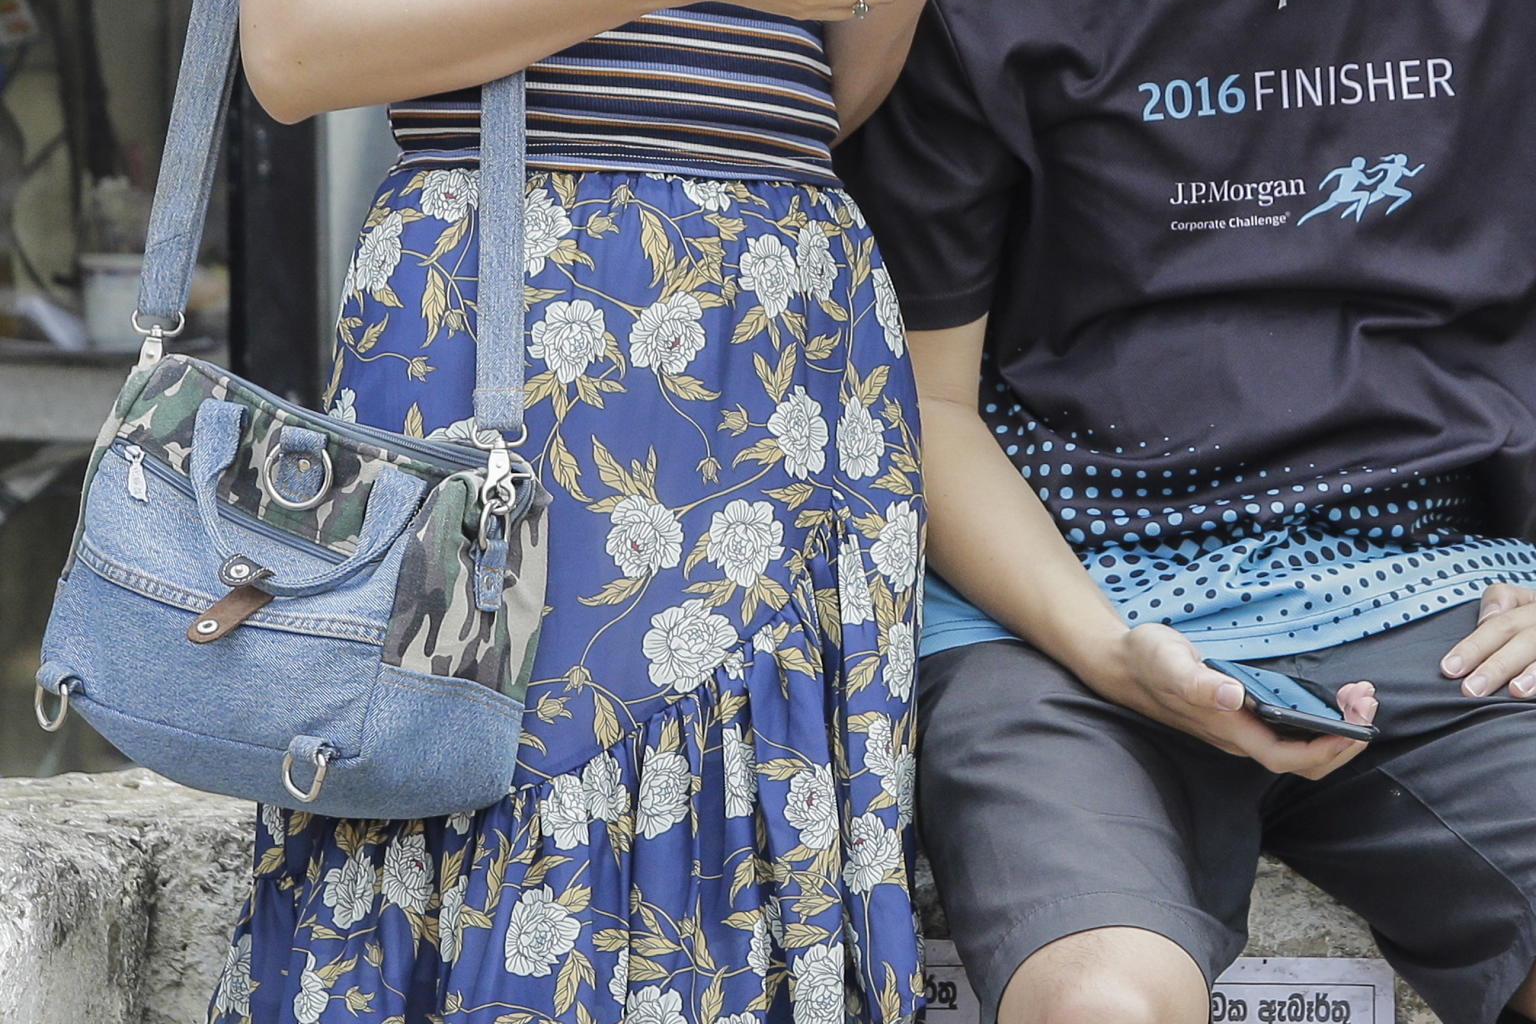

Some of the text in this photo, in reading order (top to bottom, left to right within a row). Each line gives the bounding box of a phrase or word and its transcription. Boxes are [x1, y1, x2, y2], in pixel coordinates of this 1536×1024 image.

[1138, 58, 1456, 121] 2016 FINISHER
[1171, 218, 1227, 231] Corporate
